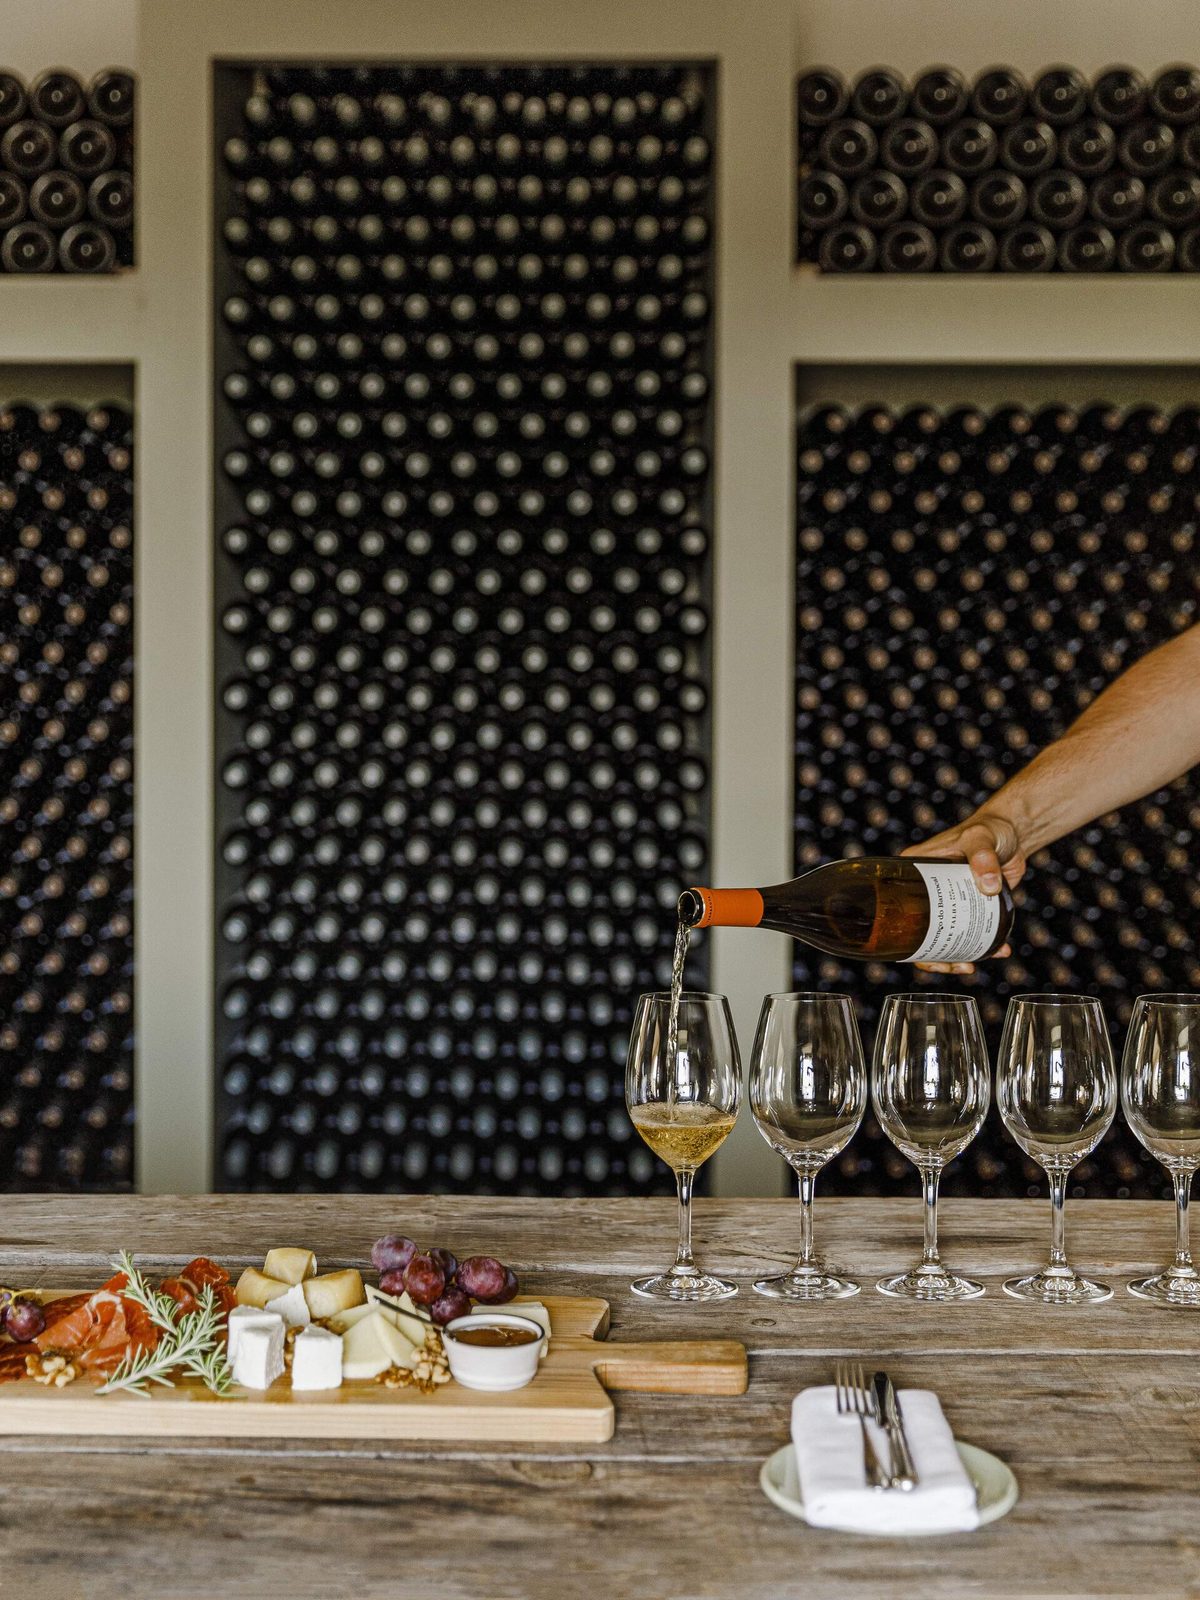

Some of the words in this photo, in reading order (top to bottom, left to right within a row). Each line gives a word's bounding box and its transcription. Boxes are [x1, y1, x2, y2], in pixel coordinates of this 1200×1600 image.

[930, 876, 944, 908] Barrocal
[938, 909, 944, 920] do
[925, 922, 944, 953] Lourenço
[947, 932, 953, 942] DE
